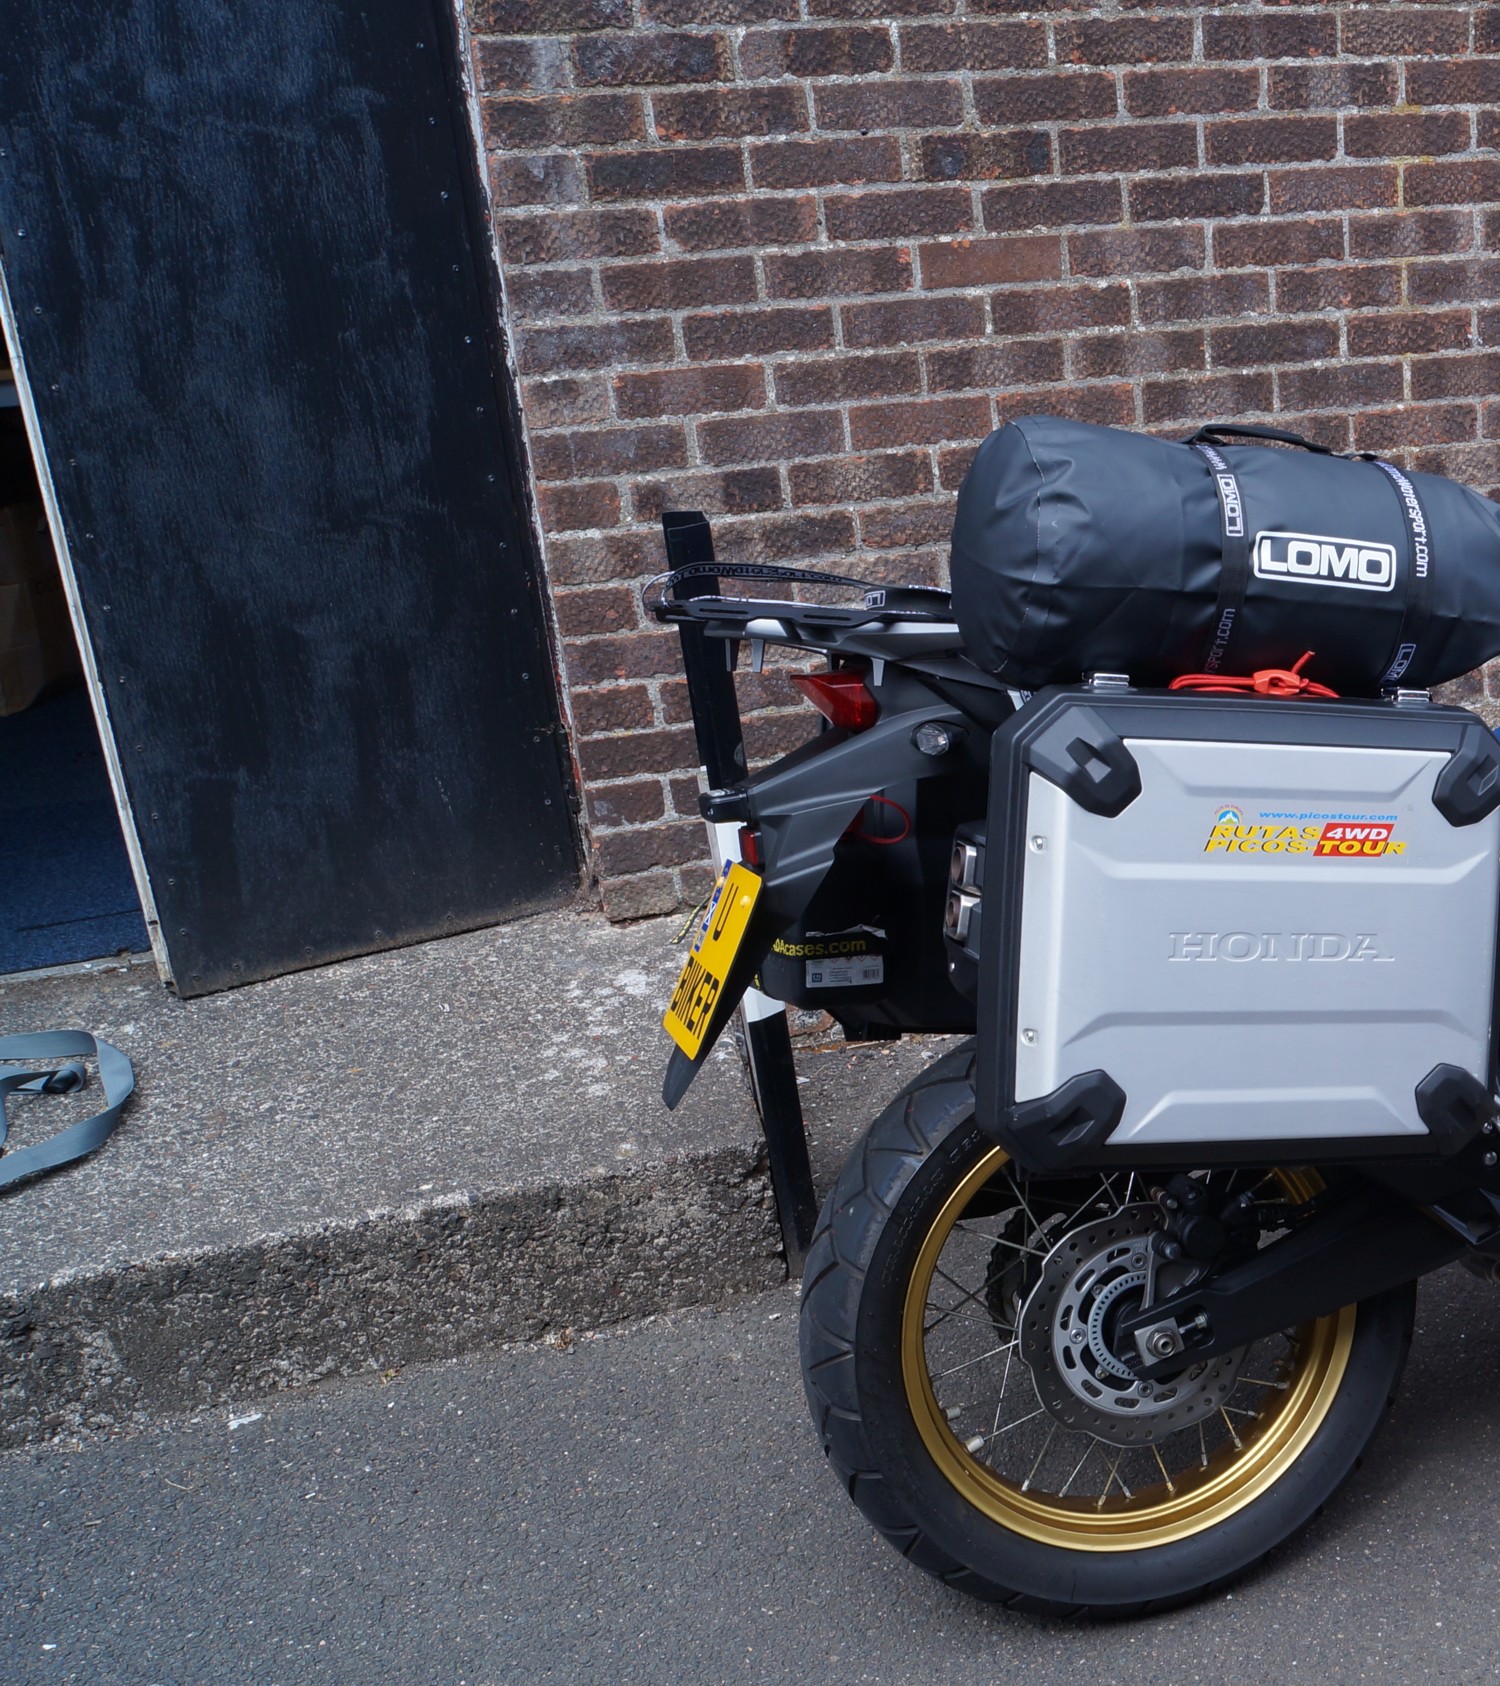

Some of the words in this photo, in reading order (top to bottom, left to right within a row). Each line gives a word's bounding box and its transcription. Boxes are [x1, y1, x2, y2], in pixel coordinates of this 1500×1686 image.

[1220, 478, 1241, 531] LOMO
[1260, 538, 1393, 583] LOMO
[1258, 811, 1398, 821] www.picostour.com
[1210, 825, 1321, 839] RUTAS
[1325, 827, 1389, 840] 4WD
[1168, 931, 1395, 962] HONDA
